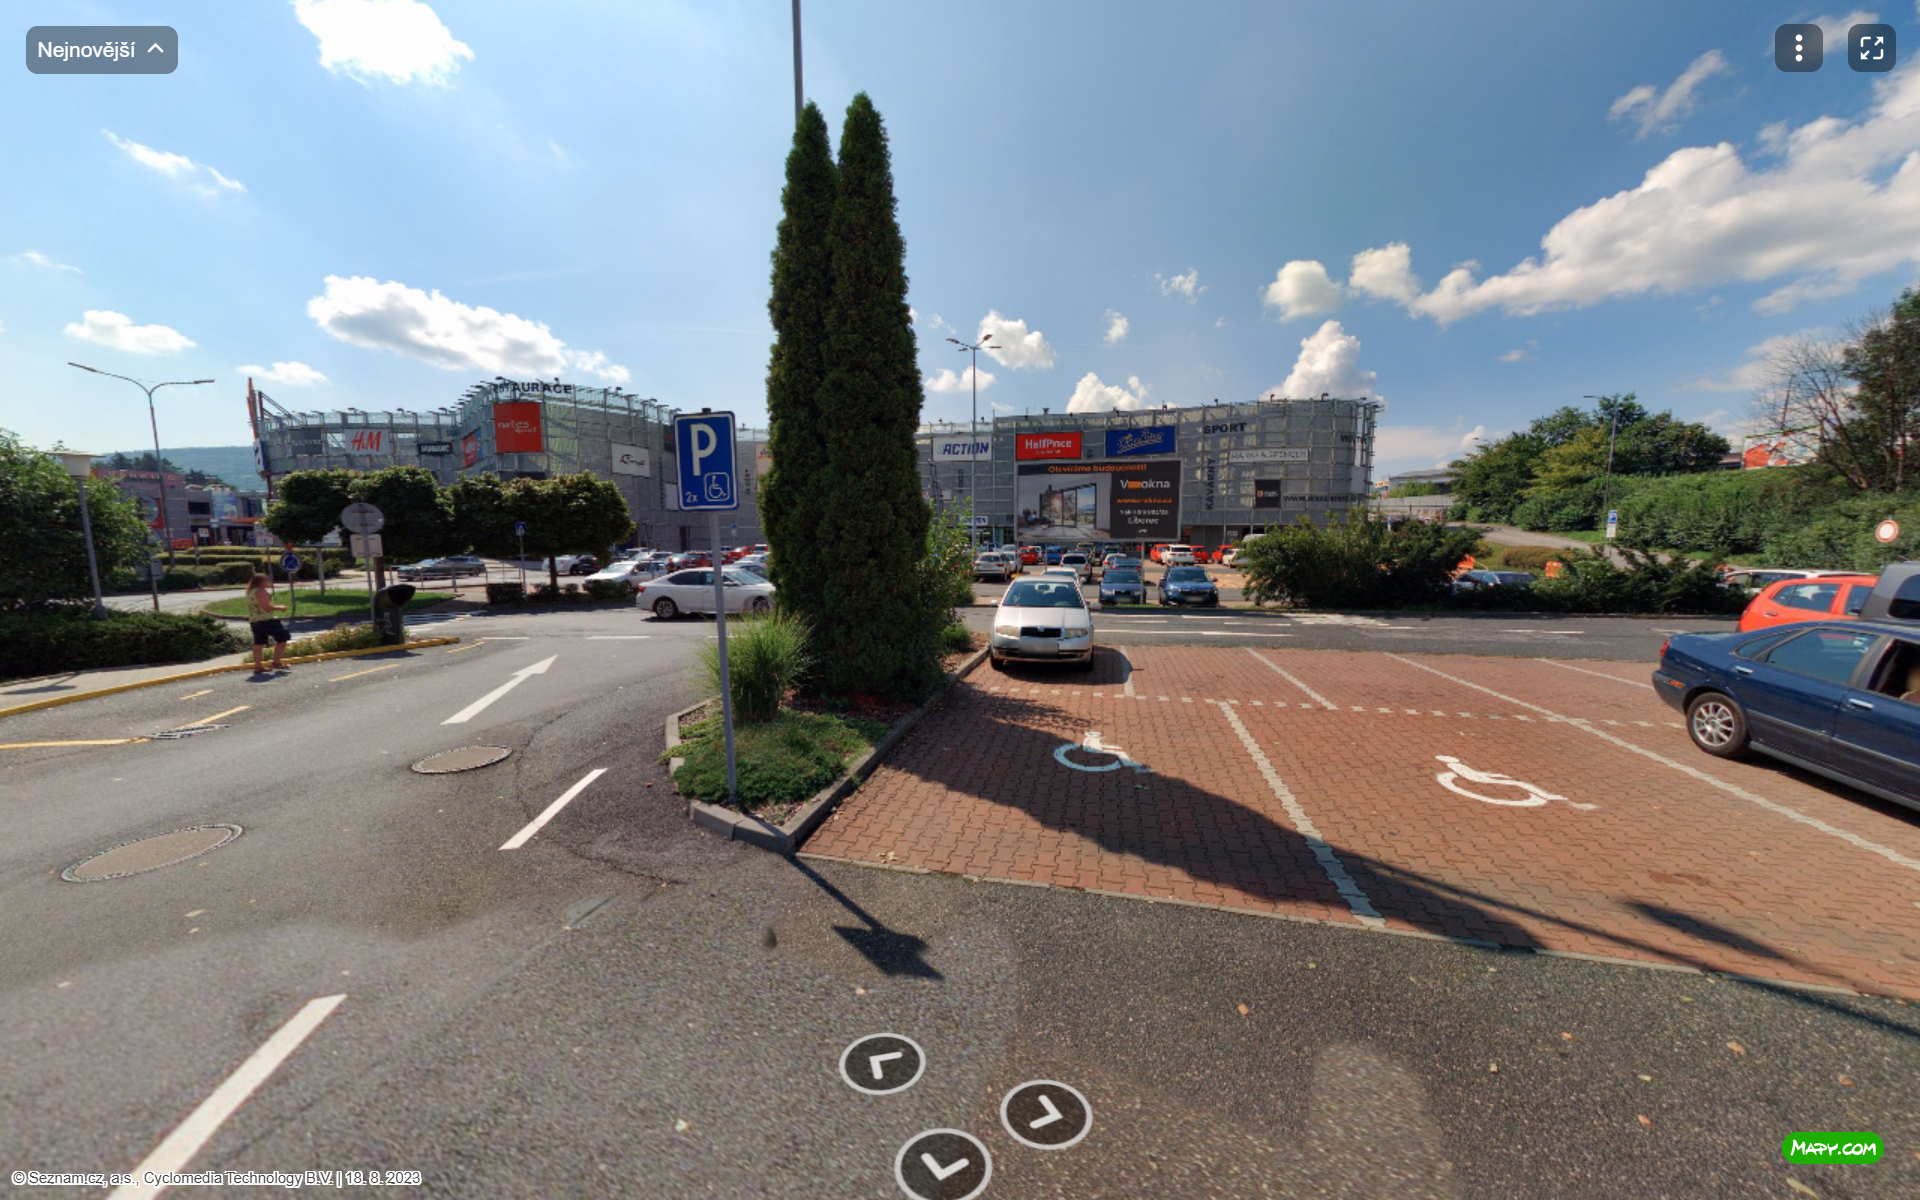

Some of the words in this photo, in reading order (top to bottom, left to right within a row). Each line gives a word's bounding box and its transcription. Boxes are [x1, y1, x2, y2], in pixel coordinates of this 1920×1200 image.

[1204, 422, 1247, 434] SPORT
[351, 431, 381, 452] H&M
[1025, 438, 1072, 450] HalfPrice
[690, 423, 717, 476] P
[942, 442, 989, 455] ACTION
[685, 492, 698, 503] 2x
[1128, 516, 1159, 525] Liberec
